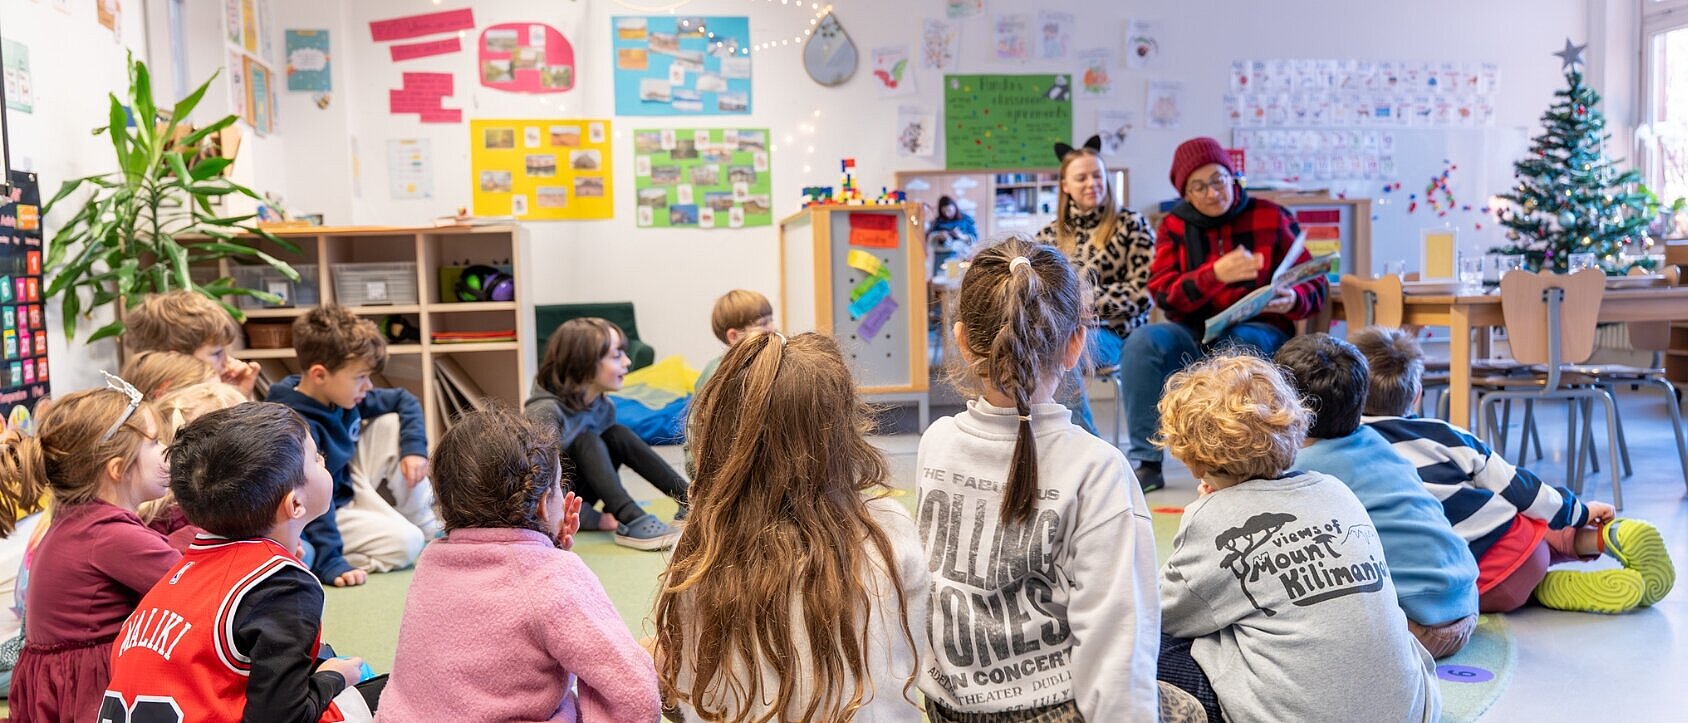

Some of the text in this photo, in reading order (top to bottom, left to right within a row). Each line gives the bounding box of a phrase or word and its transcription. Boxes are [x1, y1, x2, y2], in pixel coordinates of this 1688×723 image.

[919, 486, 1061, 591] OLLING
[1272, 518, 1343, 548] views of
[957, 686, 1023, 706] THEATER
[1031, 669, 1073, 692] DUBLI
